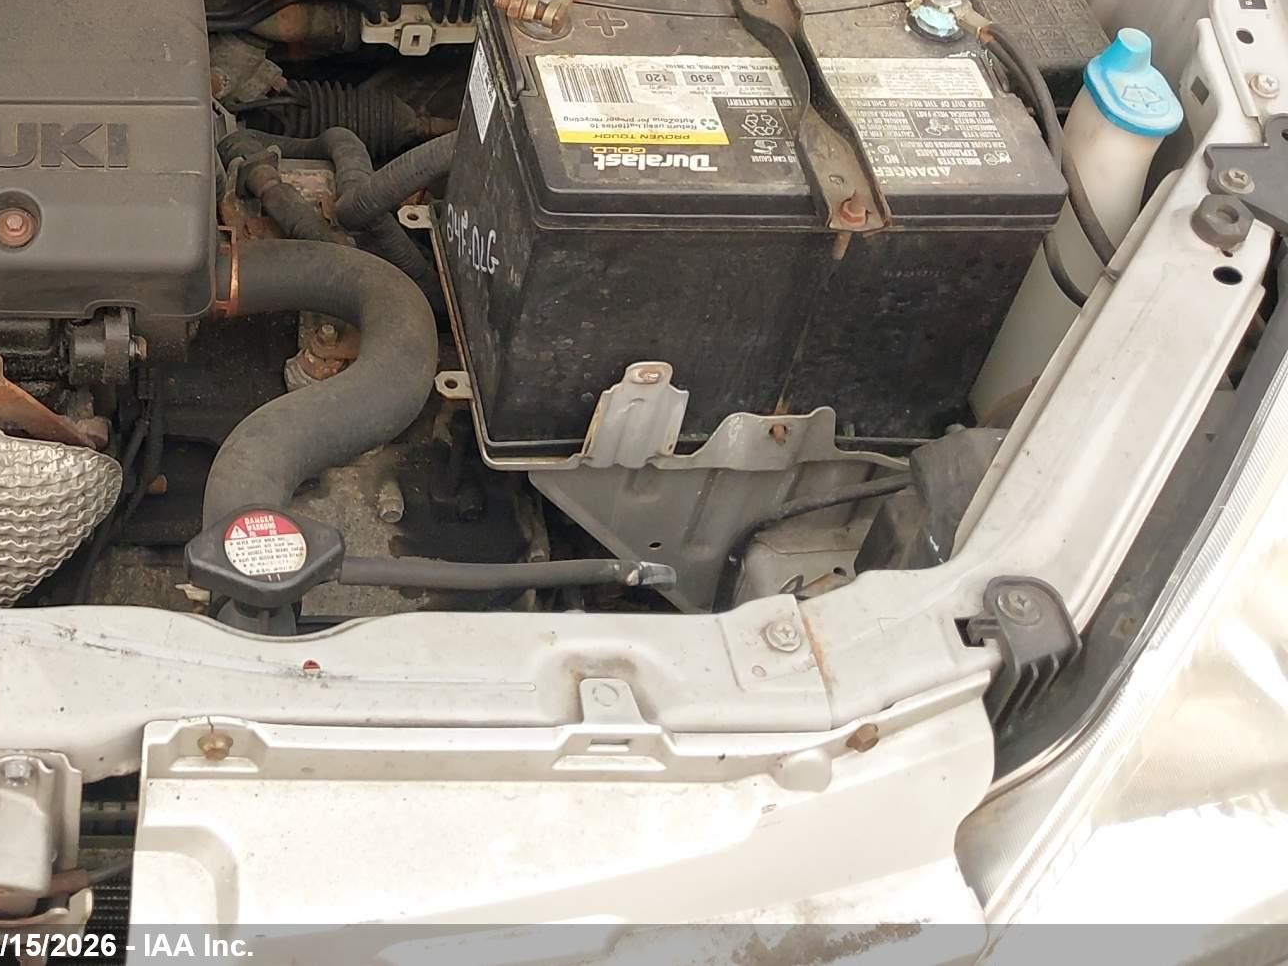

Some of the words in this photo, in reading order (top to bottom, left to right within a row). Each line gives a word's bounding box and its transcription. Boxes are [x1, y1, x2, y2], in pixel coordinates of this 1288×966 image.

[645, 73, 667, 82] 120
[690, 74, 714, 83] 930
[738, 74, 763, 83] 750
[593, 154, 719, 172] Duralast
[883, 154, 899, 163] NO
[873, 166, 941, 177] DANGER
[244, 515, 274, 524] DANGER
